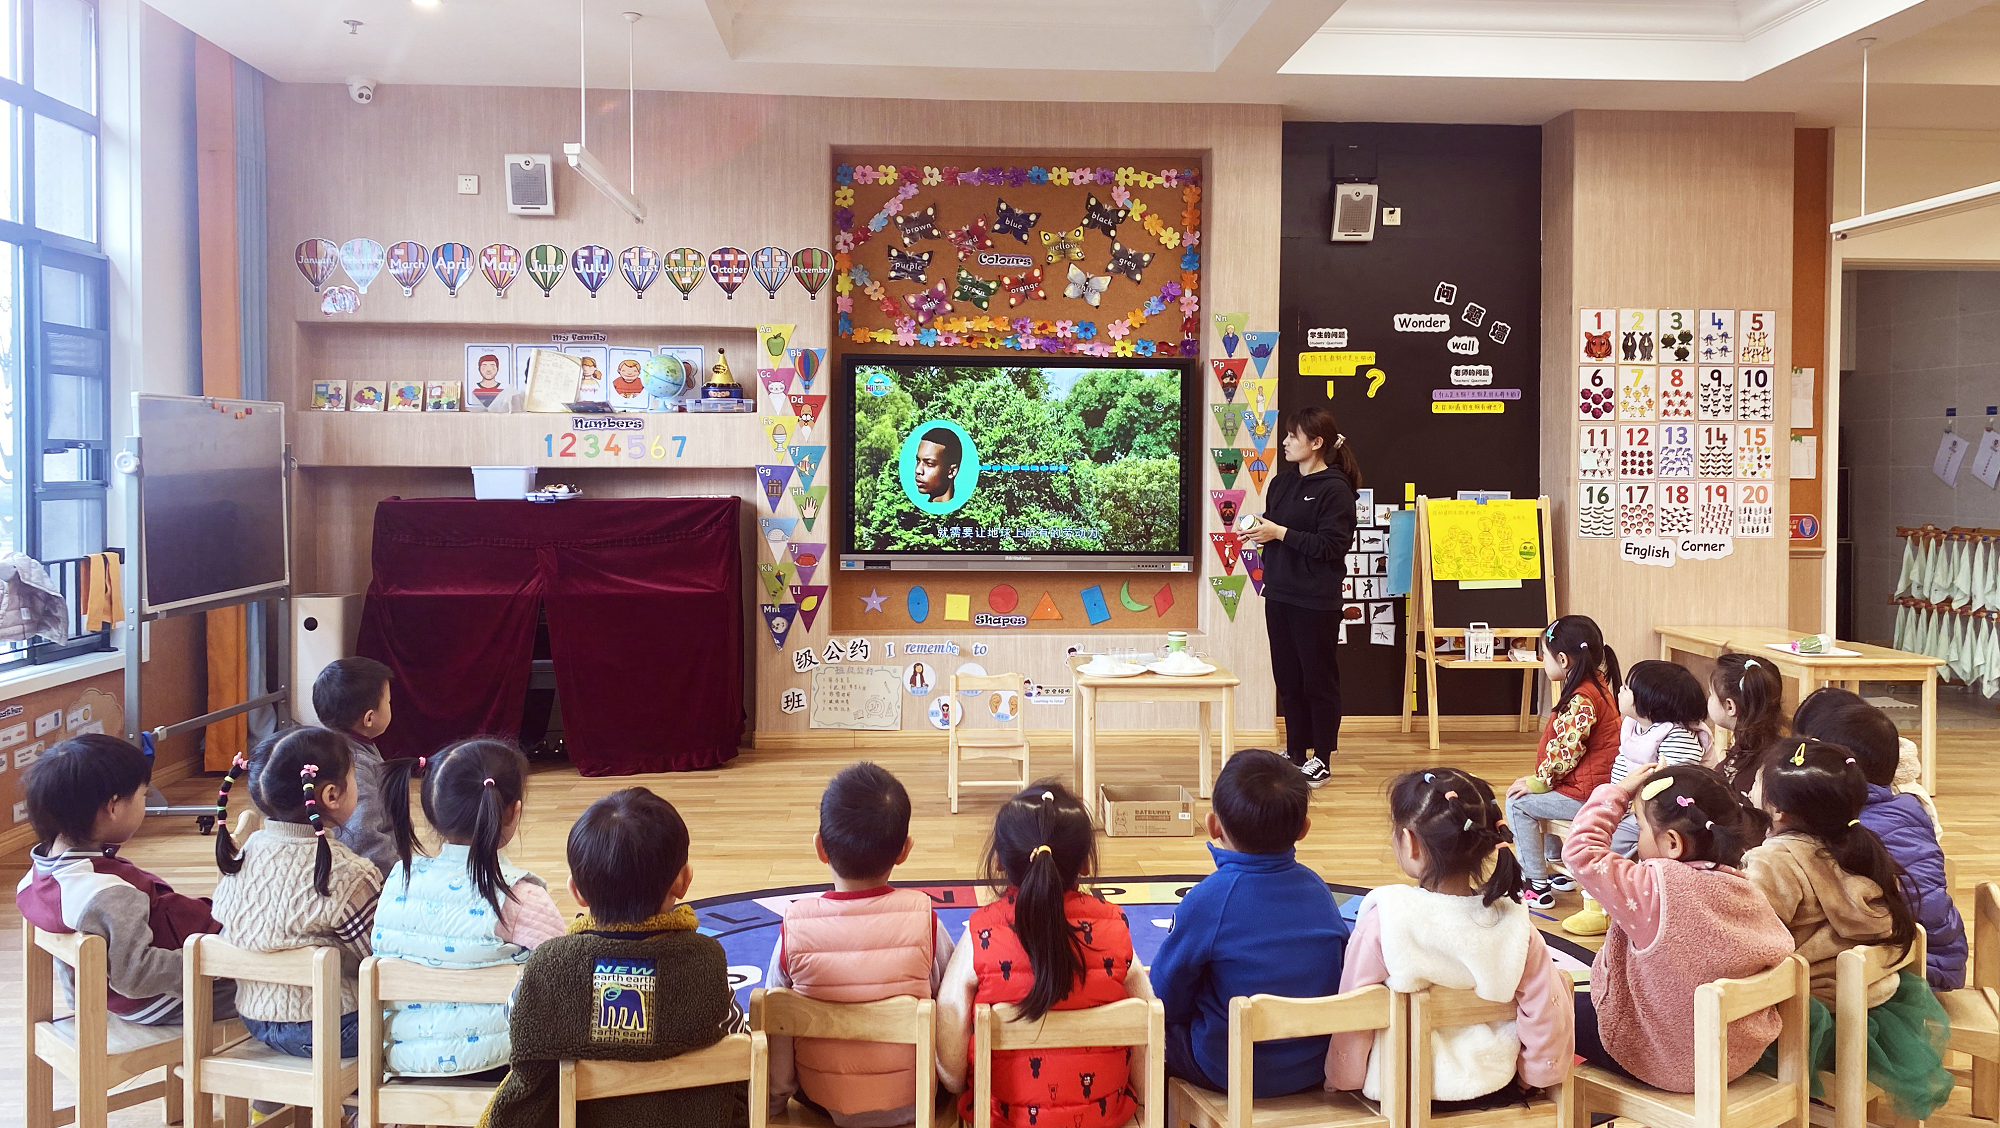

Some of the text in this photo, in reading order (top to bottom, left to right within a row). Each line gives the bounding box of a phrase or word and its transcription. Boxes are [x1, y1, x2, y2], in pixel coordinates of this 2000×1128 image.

[1004, 216, 1024, 230] blue
[1091, 211, 1113, 227] black
[905, 221, 932, 236] brown
[1049, 240, 1078, 254] yellow
[390, 258, 426, 269] March
[434, 257, 470, 271] April
[977, 252, 1033, 266] Colours
[1118, 257, 1137, 270] grey
[481, 257, 517, 277] May
[529, 259, 564, 273] June
[574, 258, 609, 278] July
[621, 264, 659, 275] August
[664, 264, 707, 274] September
[710, 264, 748, 274] October
[752, 265, 792, 274] November
[793, 266, 831, 274] December
[894, 259, 923, 273] purple
[962, 283, 986, 297] green
[1010, 281, 1040, 295] orange
[921, 298, 941, 312] pink
[1214, 314, 1227, 322] Nn
[1398, 316, 1447, 329] Wonder
[1594, 311, 1602, 330] 1
[1631, 311, 1644, 330] 2
[1670, 311, 1683, 330] 3
[1711, 312, 1724, 330] 4
[1751, 312, 1764, 331] 5
[759, 325, 772, 333] Aa
[1309, 331, 1346, 339] 学生的问题
[1245, 333, 1257, 341] Oo
[1451, 340, 1475, 352] wall
[790, 349, 802, 357] Bb
[1213, 360, 1225, 370] Pp
[760, 370, 771, 378] Cc
[1454, 368, 1490, 377] 老师的问题
[1591, 368, 1604, 387] 6
[1631, 368, 1644, 387] 7
[1670, 368, 1684, 387] 8
[1710, 369, 1722, 387] 9
[1744, 369, 1768, 387] 10
[1242, 381, 1256, 391] Qq
[791, 395, 804, 404] Dd
[1213, 405, 1224, 413] Rr
[1244, 412, 1254, 420] Ss
[573, 417, 643, 429] Numbers
[1587, 428, 1608, 447] 11
[1626, 427, 1649, 446] 12
[1665, 426, 1688, 445] 13
[1705, 427, 1728, 445] 14
[1743, 427, 1767, 446] 15
[544, 433, 687, 460] 1 2 3 4 5 6 7
[790, 447, 800, 457] Ff
[1213, 450, 1223, 458] Tt
[1242, 450, 1255, 458] Uu
[758, 466, 771, 476] Gg
[792, 487, 805, 496] Hh
[1212, 491, 1224, 499] Vv
[1586, 486, 1610, 504] 16
[1625, 485, 1649, 504] 17
[1665, 485, 1689, 504] 18
[1705, 484, 1728, 503] 19
[1742, 485, 1768, 504] 20
[761, 518, 769, 527] Ii
[1212, 534, 1224, 542] Xx
[790, 544, 799, 554] Jj
[1624, 541, 1726, 560] English Corner
[1241, 551, 1253, 561] Yy
[761, 564, 774, 572] Kk
[1212, 578, 1223, 586] Zz
[792, 586, 801, 595] Ll
[975, 614, 1026, 627] Shapes
[886, 643, 895, 658] I
[973, 644, 987, 656] to
[594, 964, 655, 975] NEW
[593, 974, 655, 984] earth earth
[591, 1028, 653, 1039] earth earth
[621, 1037, 652, 1045] earth
